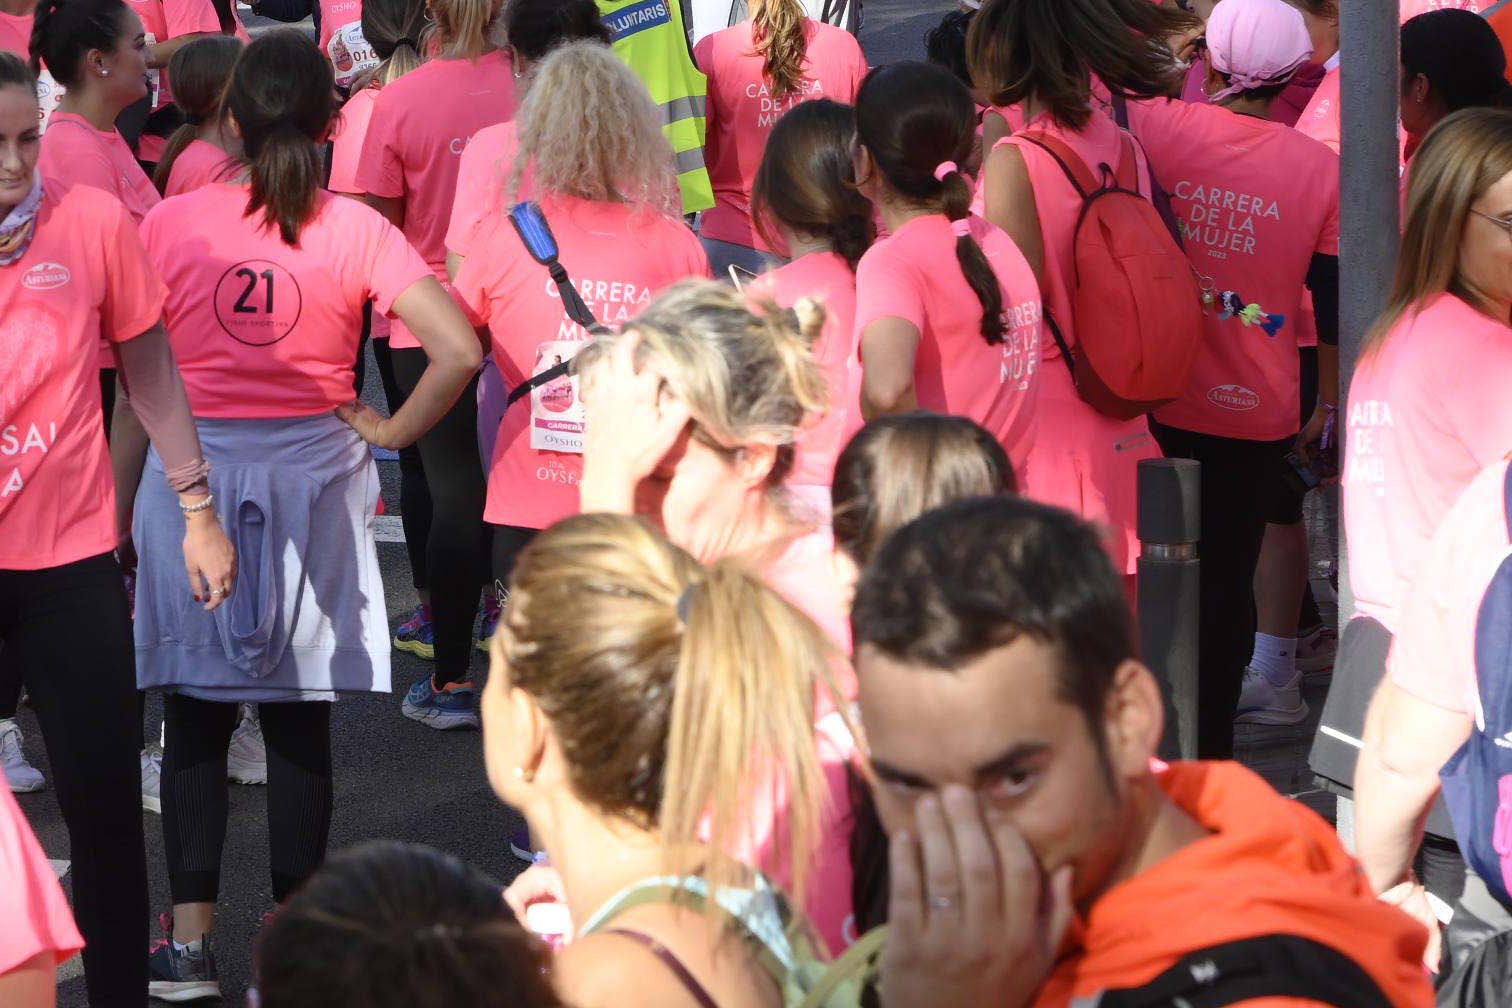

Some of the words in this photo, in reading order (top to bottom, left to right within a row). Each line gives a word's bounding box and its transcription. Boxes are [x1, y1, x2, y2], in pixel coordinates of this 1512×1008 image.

[762, 98, 781, 112] DE
[1176, 181, 1280, 220] CARRERA
[1191, 204, 1220, 226] DE
[1229, 212, 1255, 234] LA
[1184, 223, 1256, 255] MUJER
[233, 268, 273, 313] 21
[603, 305, 628, 322] LA
[1212, 390, 1256, 406] ASTURIANA
